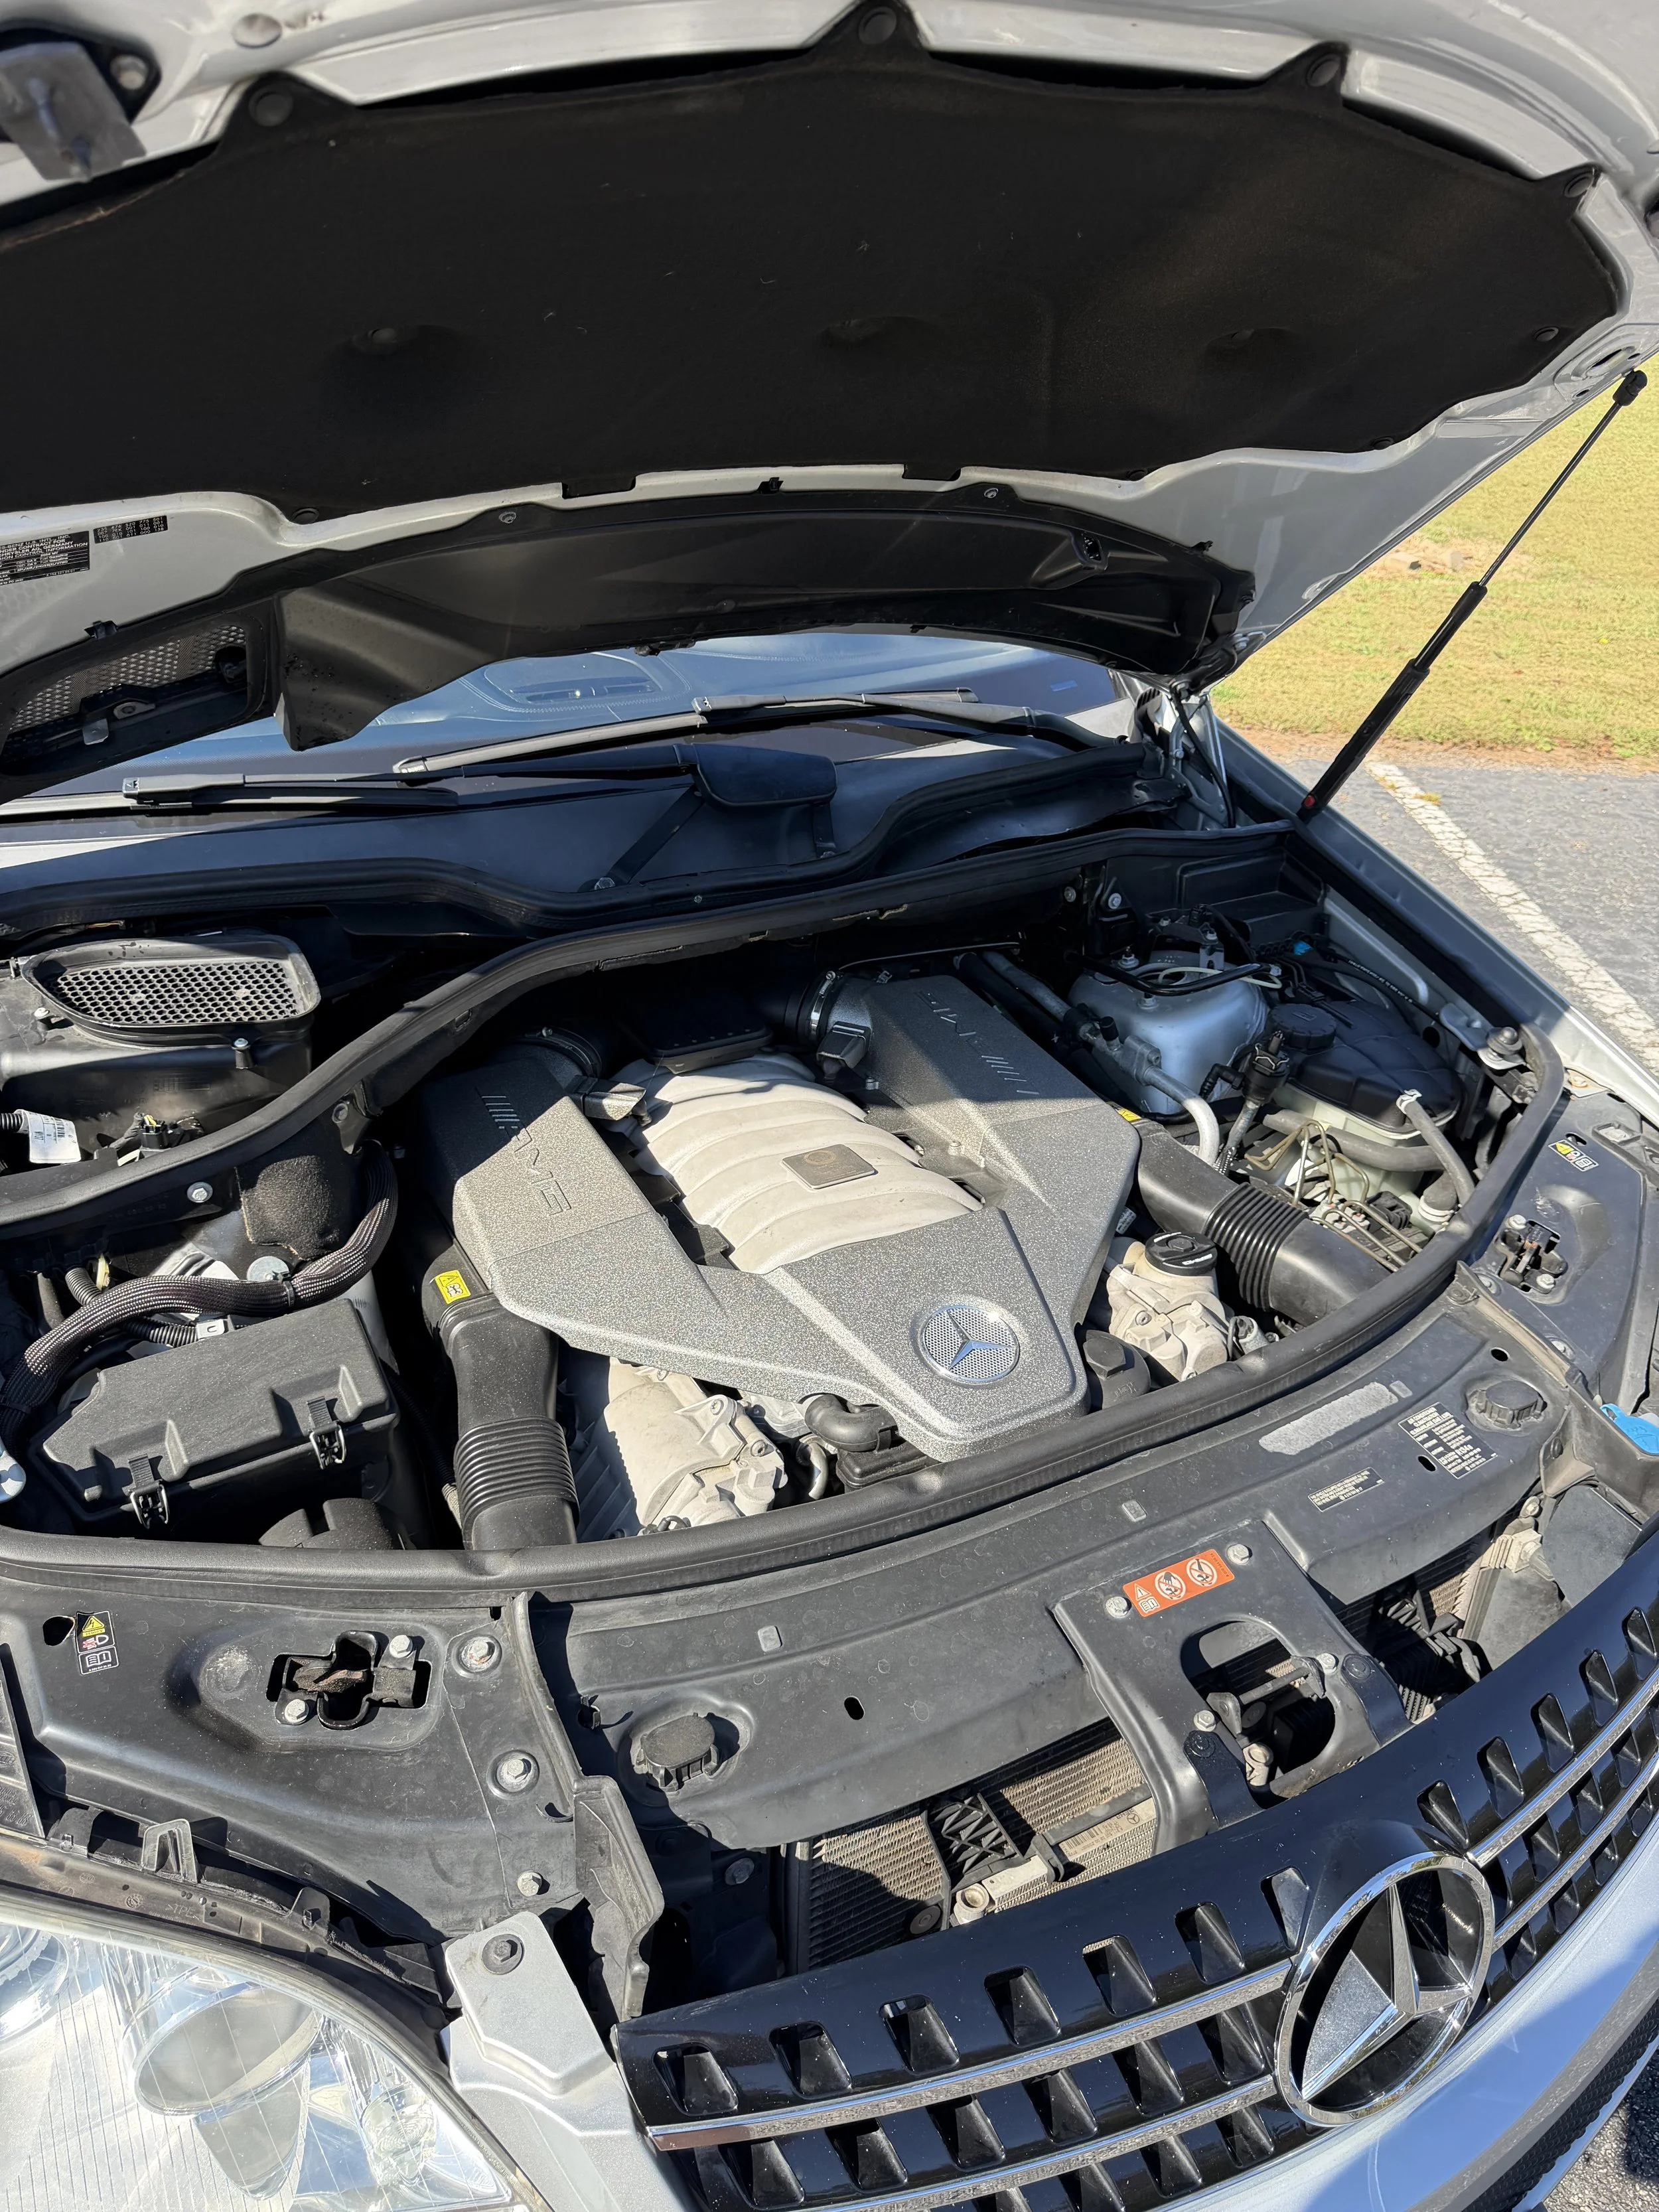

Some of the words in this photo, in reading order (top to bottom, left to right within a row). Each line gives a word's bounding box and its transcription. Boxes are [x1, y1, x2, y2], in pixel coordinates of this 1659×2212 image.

[19, 542, 51, 550] CONTRACT
[43, 541, 73, 550] GERMANY
[46, 542, 88, 552] INFORMATION
